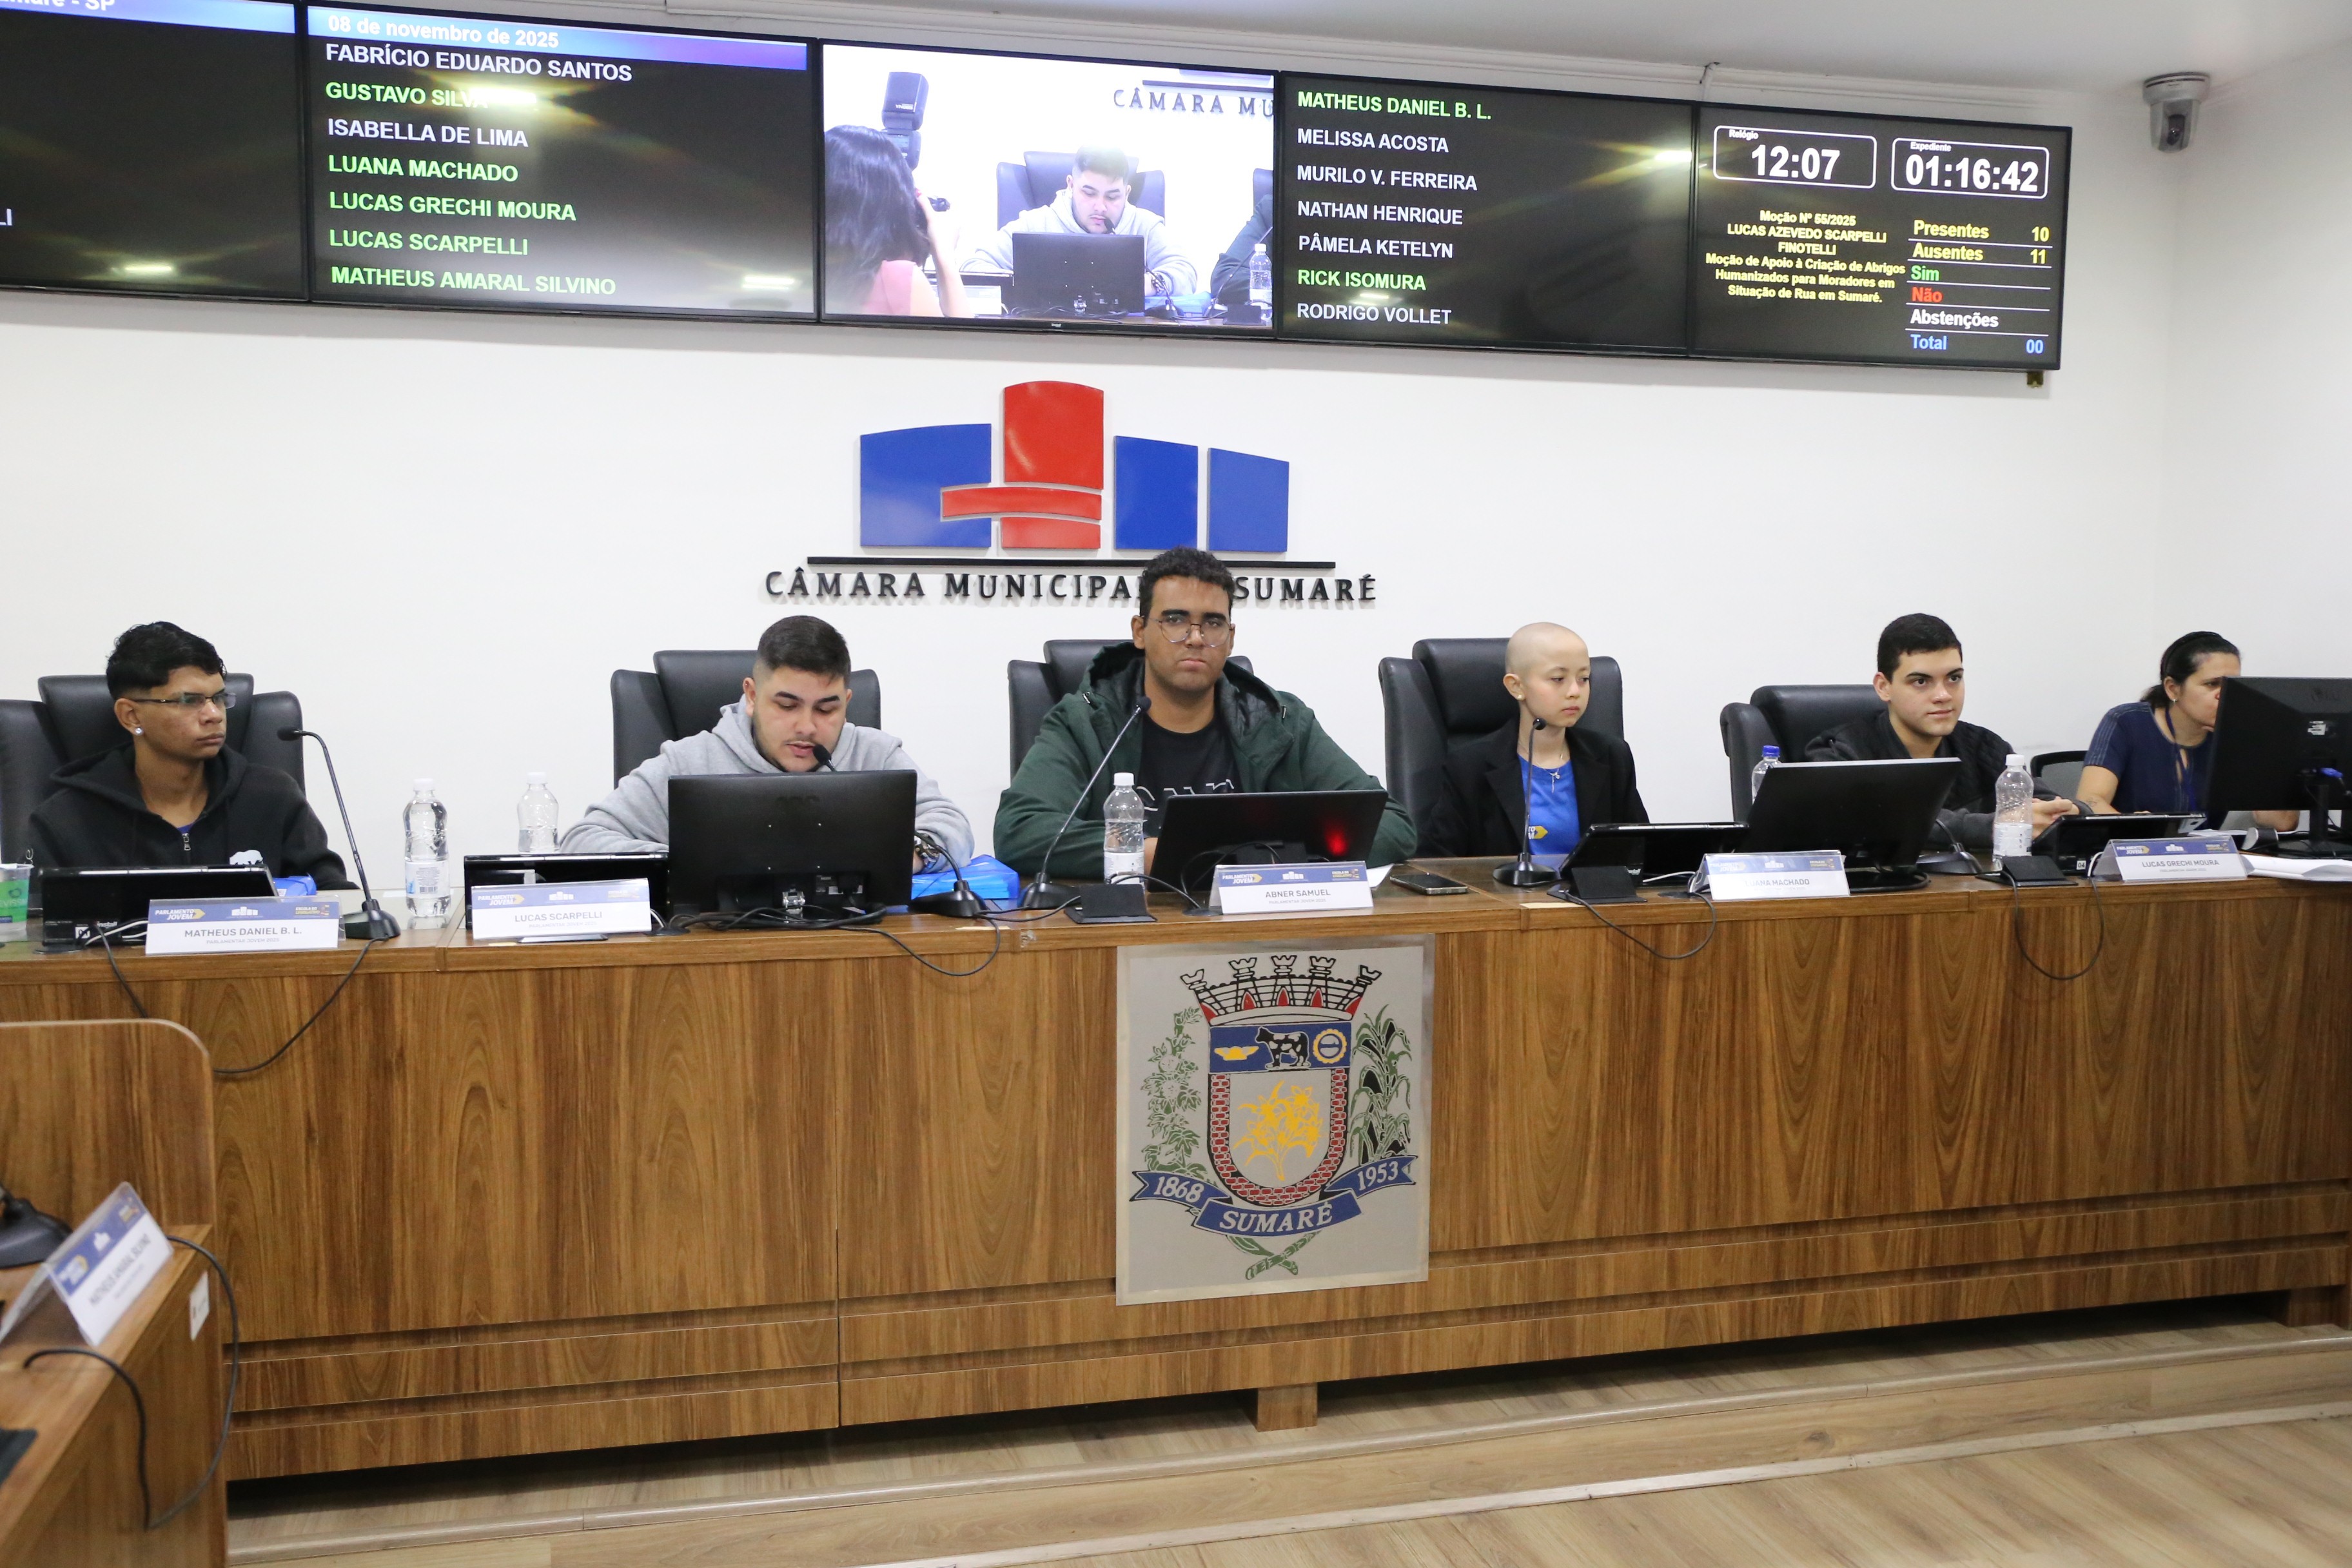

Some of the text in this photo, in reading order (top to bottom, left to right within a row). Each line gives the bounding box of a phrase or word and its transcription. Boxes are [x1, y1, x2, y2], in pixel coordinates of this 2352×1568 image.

[328, 15, 559, 48] 08 de novembro de 2025
[326, 43, 632, 81] FABRÍCIO EDUARDO SANTOS
[326, 81, 426, 105] GUSTAVO
[1113, 87, 1224, 113] CÂMARA
[1298, 91, 1491, 120] MATHEUS DANIEL B. L.
[328, 118, 528, 147] ISABELLA DE LIMA
[1297, 128, 1449, 153] MELISSA ACOSTA
[1729, 129, 1759, 141] Relógio
[1910, 141, 1952, 152] Expediente
[328, 155, 518, 182] LUANA MACHADO
[1752, 144, 1840, 180] 12:07
[1905, 154, 2039, 191] 01:16:42
[1297, 165, 1478, 191] MURILO V. FERREIRA
[329, 191, 576, 221] LUCAS GRECHI MOURA
[1298, 201, 1463, 225] NATHAN HENRIQUE
[1759, 210, 1797, 224] Moção
[329, 230, 528, 255] LUCAS SCARPELLI
[1727, 223, 1886, 243] LUCAS AZEVEDO SCARPELLI
[1914, 220, 2050, 242] Presentes 10
[1298, 232, 1453, 259] PÂMELA KETELYN
[1778, 242, 1836, 255] FINOTELLI
[1912, 242, 2046, 264] Ausentes 11
[1705, 253, 1906, 276] Moção de Apoio à Criação de Abrigos
[1910, 266, 1939, 281] Sim
[331, 266, 616, 295] MATHEUS AMARAL SILVINO
[1298, 270, 1427, 290] RICK ISOMURA
[1715, 269, 1895, 288] Humanizados para Moradores em
[1728, 285, 1883, 303] Situação de Rua em Sumaré.
[1912, 287, 1943, 302] Não
[1297, 303, 1452, 324] RODRIGO VOLLET
[1910, 309, 1999, 329] Abstenções
[1910, 334, 2044, 354] Total 00
[765, 567, 1377, 601] CÂMARA MUNICIPA SUMARÉ
[1266, 888, 1331, 898] ABNER SAMUEL
[1772, 878, 1810, 887] MACHADO
[515, 912, 602, 922] LUCAS SCARPELLI
[184, 927, 237, 937] MATHEUS
[239, 927, 278, 936] DANIEL
[1357, 1162, 1399, 1191] 1953
[1153, 1176, 1205, 1204] 1868
[1219, 1203, 1333, 1233] SUMARÉ
